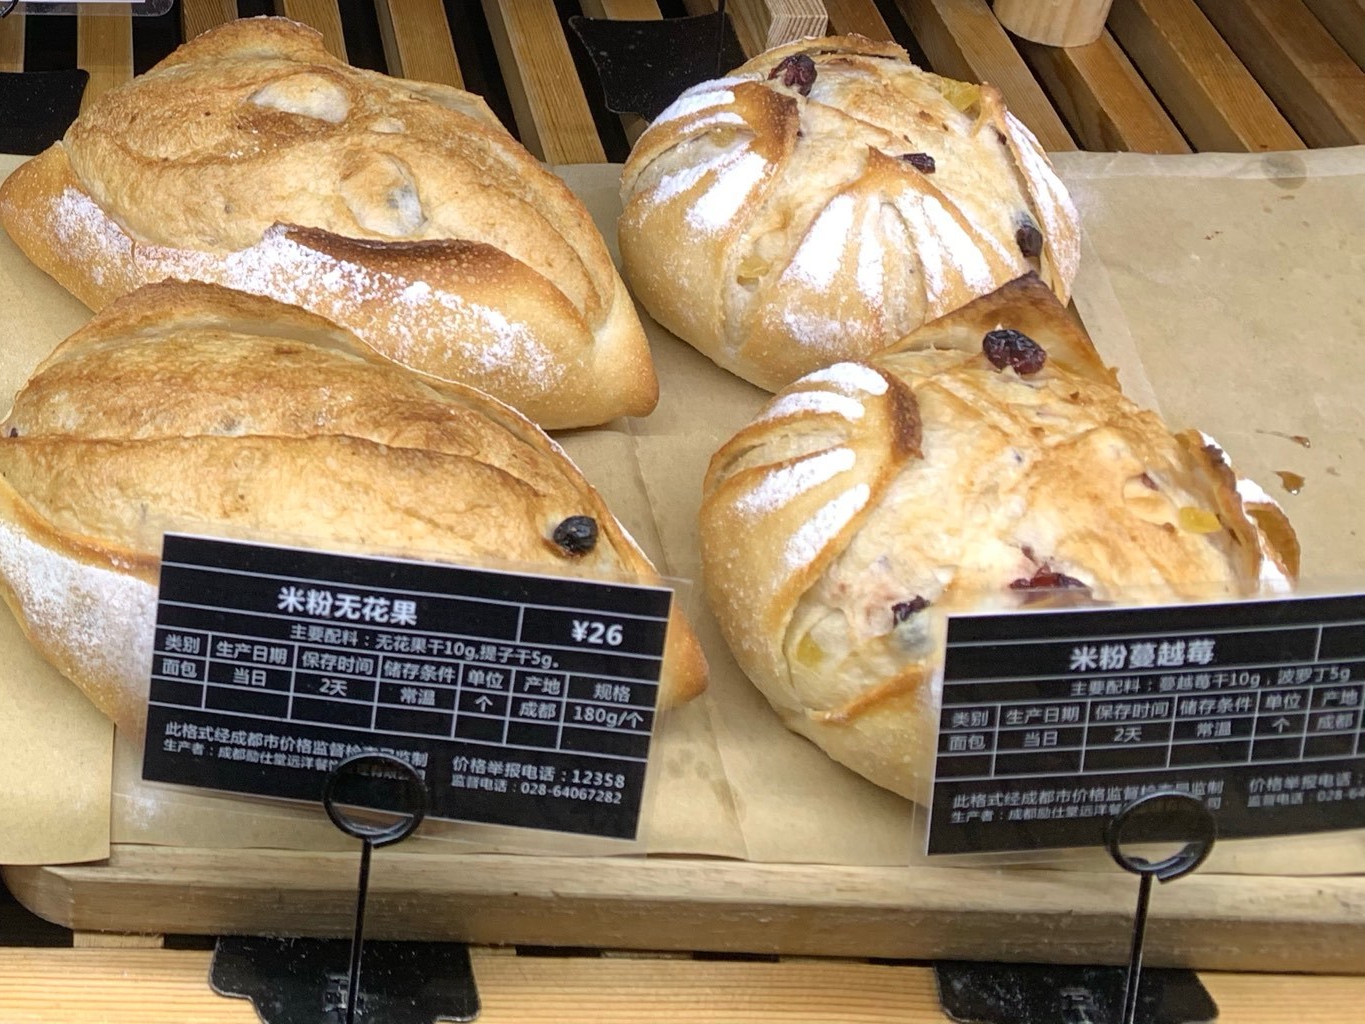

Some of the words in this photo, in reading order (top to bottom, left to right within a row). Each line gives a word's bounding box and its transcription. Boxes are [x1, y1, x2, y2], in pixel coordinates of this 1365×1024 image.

[277, 585, 419, 626] 米粉无花果
[570, 619, 624, 646] ¥26
[164, 633, 200, 654] 类别
[215, 639, 288, 665] 生产日期
[301, 650, 374, 675] 保存时间
[382, 659, 456, 684] 储存条件
[466, 668, 504, 689] 单位
[523, 674, 562, 695] 产地
[592, 682, 632, 703] 规格
[1069, 639, 1215, 671] 米粉蔓越莓
[161, 657, 198, 678] 面包
[232, 666, 267, 687] 当日
[318, 677, 348, 697] 2天
[399, 685, 437, 706] 常温
[474, 694, 494, 713] 个
[518, 699, 557, 722] 成都
[572, 706, 644, 731] 180g/个
[951, 710, 989, 728] 类别
[1005, 705, 1080, 725] 生产日期
[948, 734, 986, 752] 面包
[1023, 730, 1058, 747] 当日
[1112, 726, 1142, 743] 2天
[1271, 717, 1291, 734] 个
